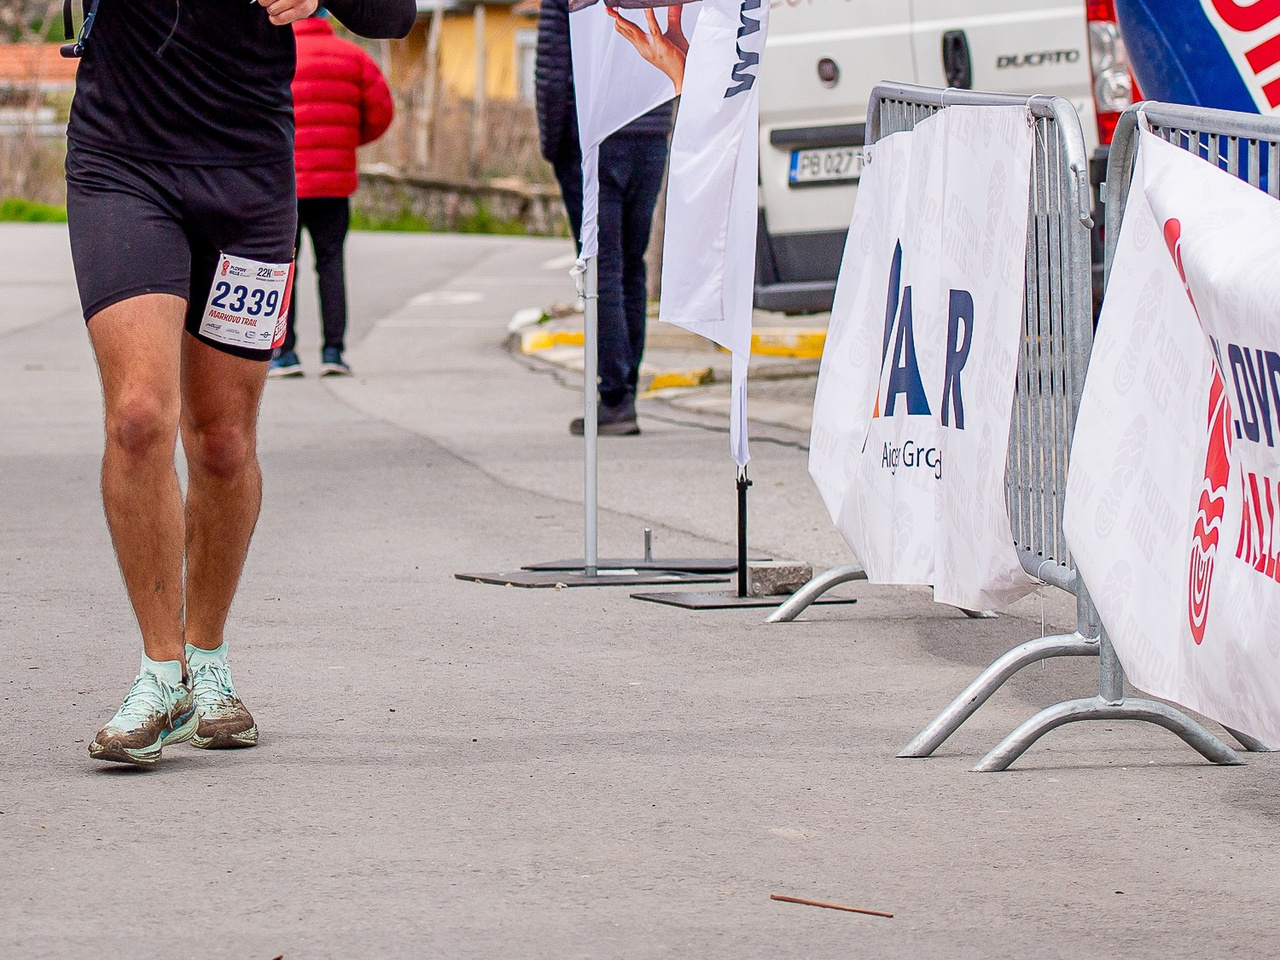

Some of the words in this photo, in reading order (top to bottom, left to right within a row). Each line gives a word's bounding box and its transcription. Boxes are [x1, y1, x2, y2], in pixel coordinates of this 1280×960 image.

[996, 49, 1081, 69] DUCATO
[257, 268, 273, 278] 22K
[211, 281, 279, 317] 2339
[208, 309, 241, 324] MARKOVO
[241, 316, 258, 327] TRAIL
